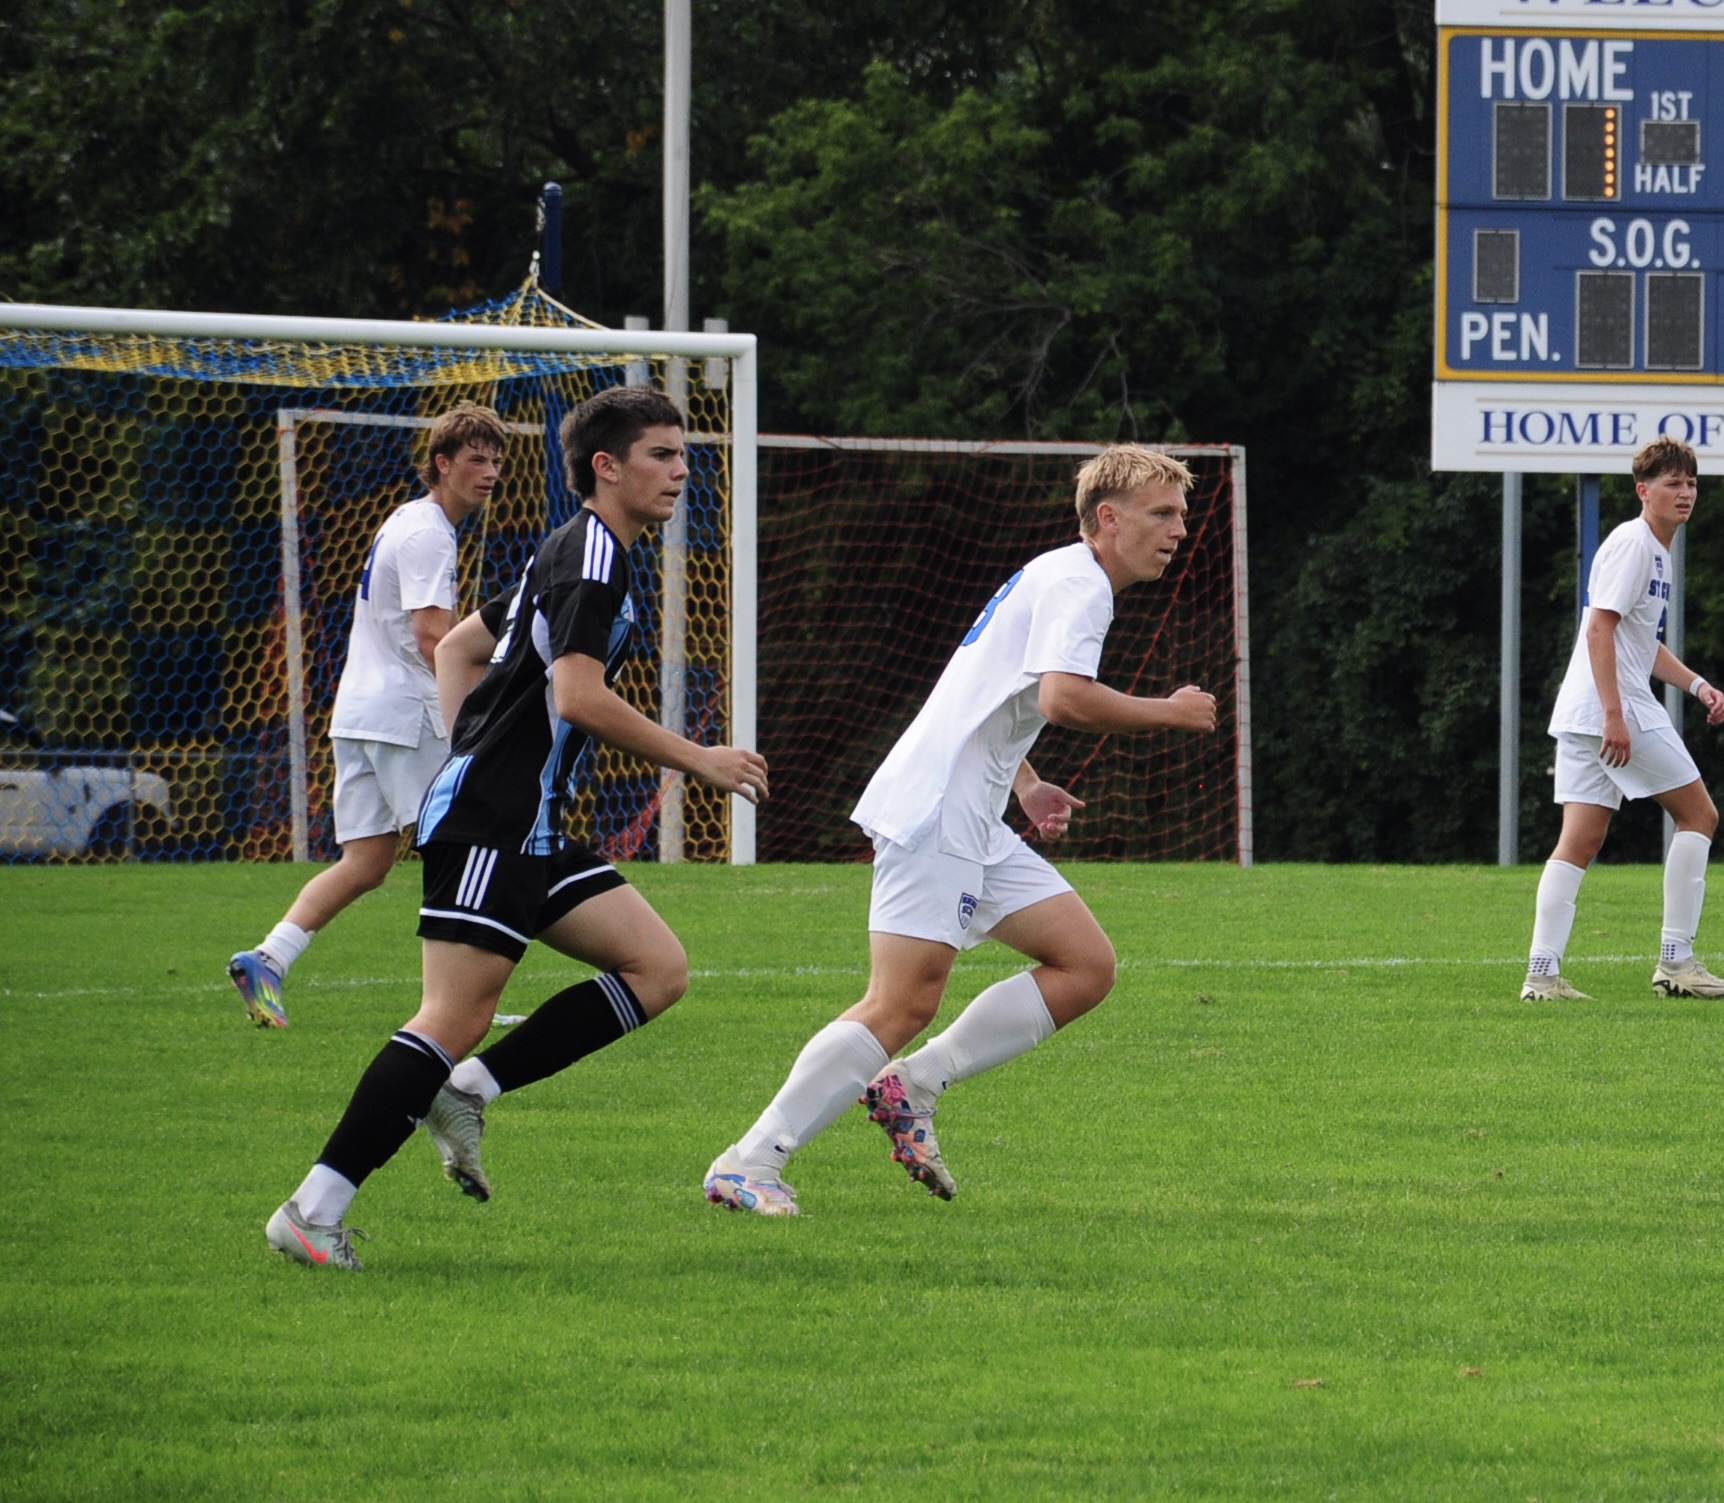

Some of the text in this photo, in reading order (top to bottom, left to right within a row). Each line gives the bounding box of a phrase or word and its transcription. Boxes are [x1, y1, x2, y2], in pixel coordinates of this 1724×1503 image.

[1481, 38, 1634, 101] HOME
[1634, 163, 1706, 193] HALF
[1589, 217, 1700, 269] S.O.G.
[1461, 312, 1561, 361] PEN.
[1479, 410, 1724, 447] HOME OF
